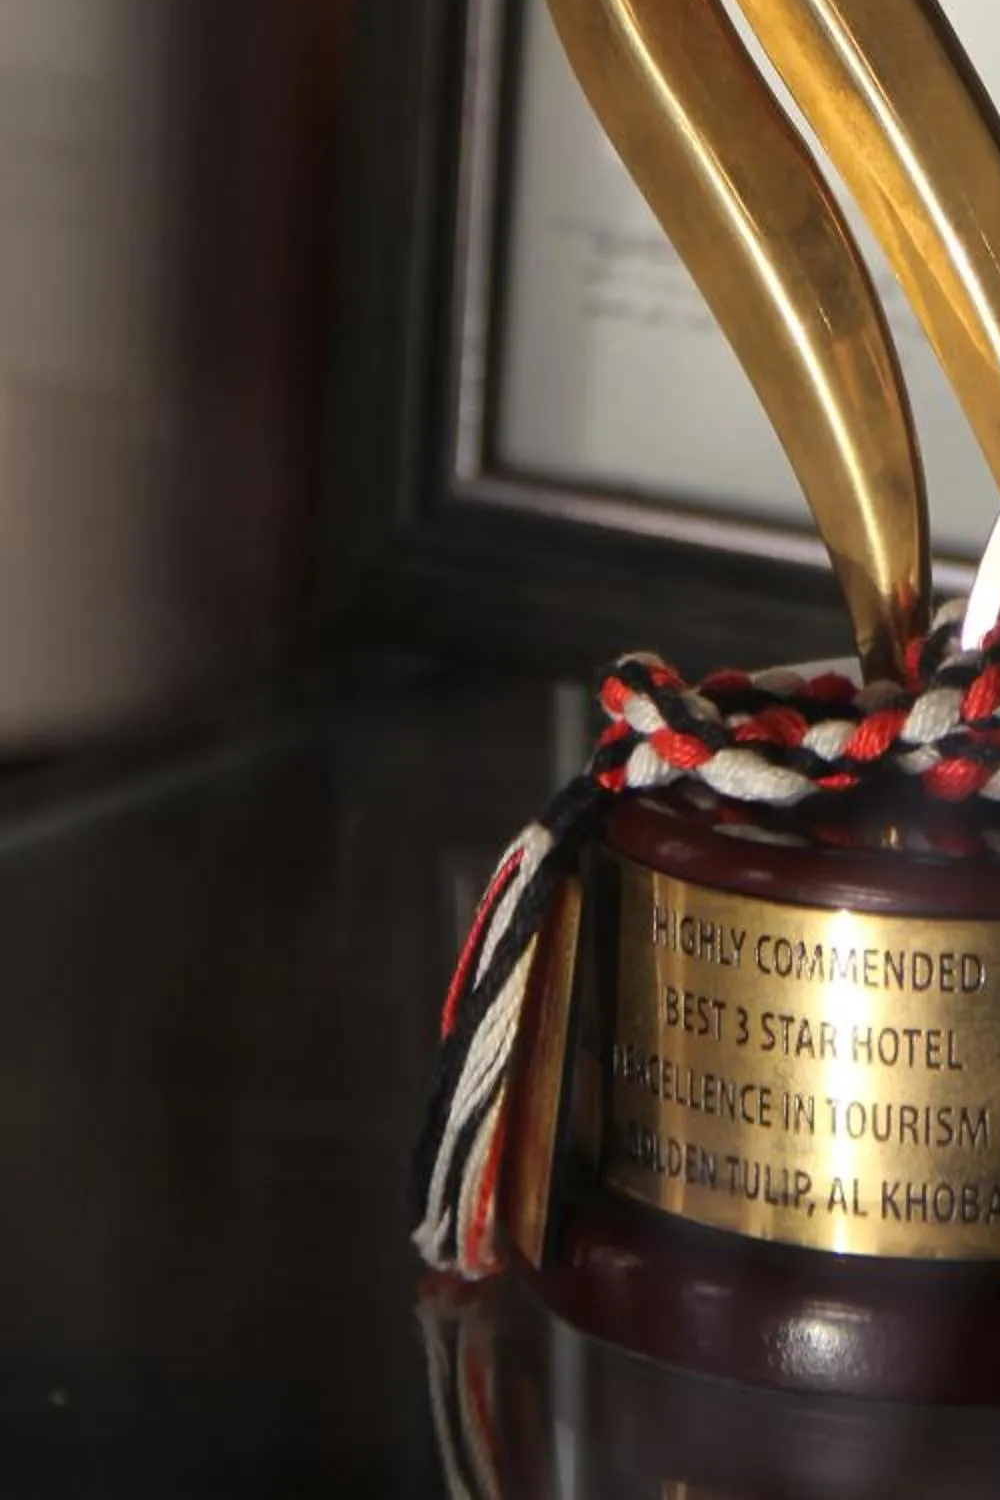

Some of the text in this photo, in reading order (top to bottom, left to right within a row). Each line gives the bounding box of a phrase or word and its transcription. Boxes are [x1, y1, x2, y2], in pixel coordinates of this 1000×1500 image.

[652, 904, 986, 994] HIGHLY COMMENDED
[664, 986, 963, 1071] BEST 3 STAR HOTEL
[781, 1091, 815, 1135] IN
[825, 1097, 990, 1149] TOURISM
[725, 1155, 816, 1218] TULIP,
[827, 1176, 869, 1219] AL
